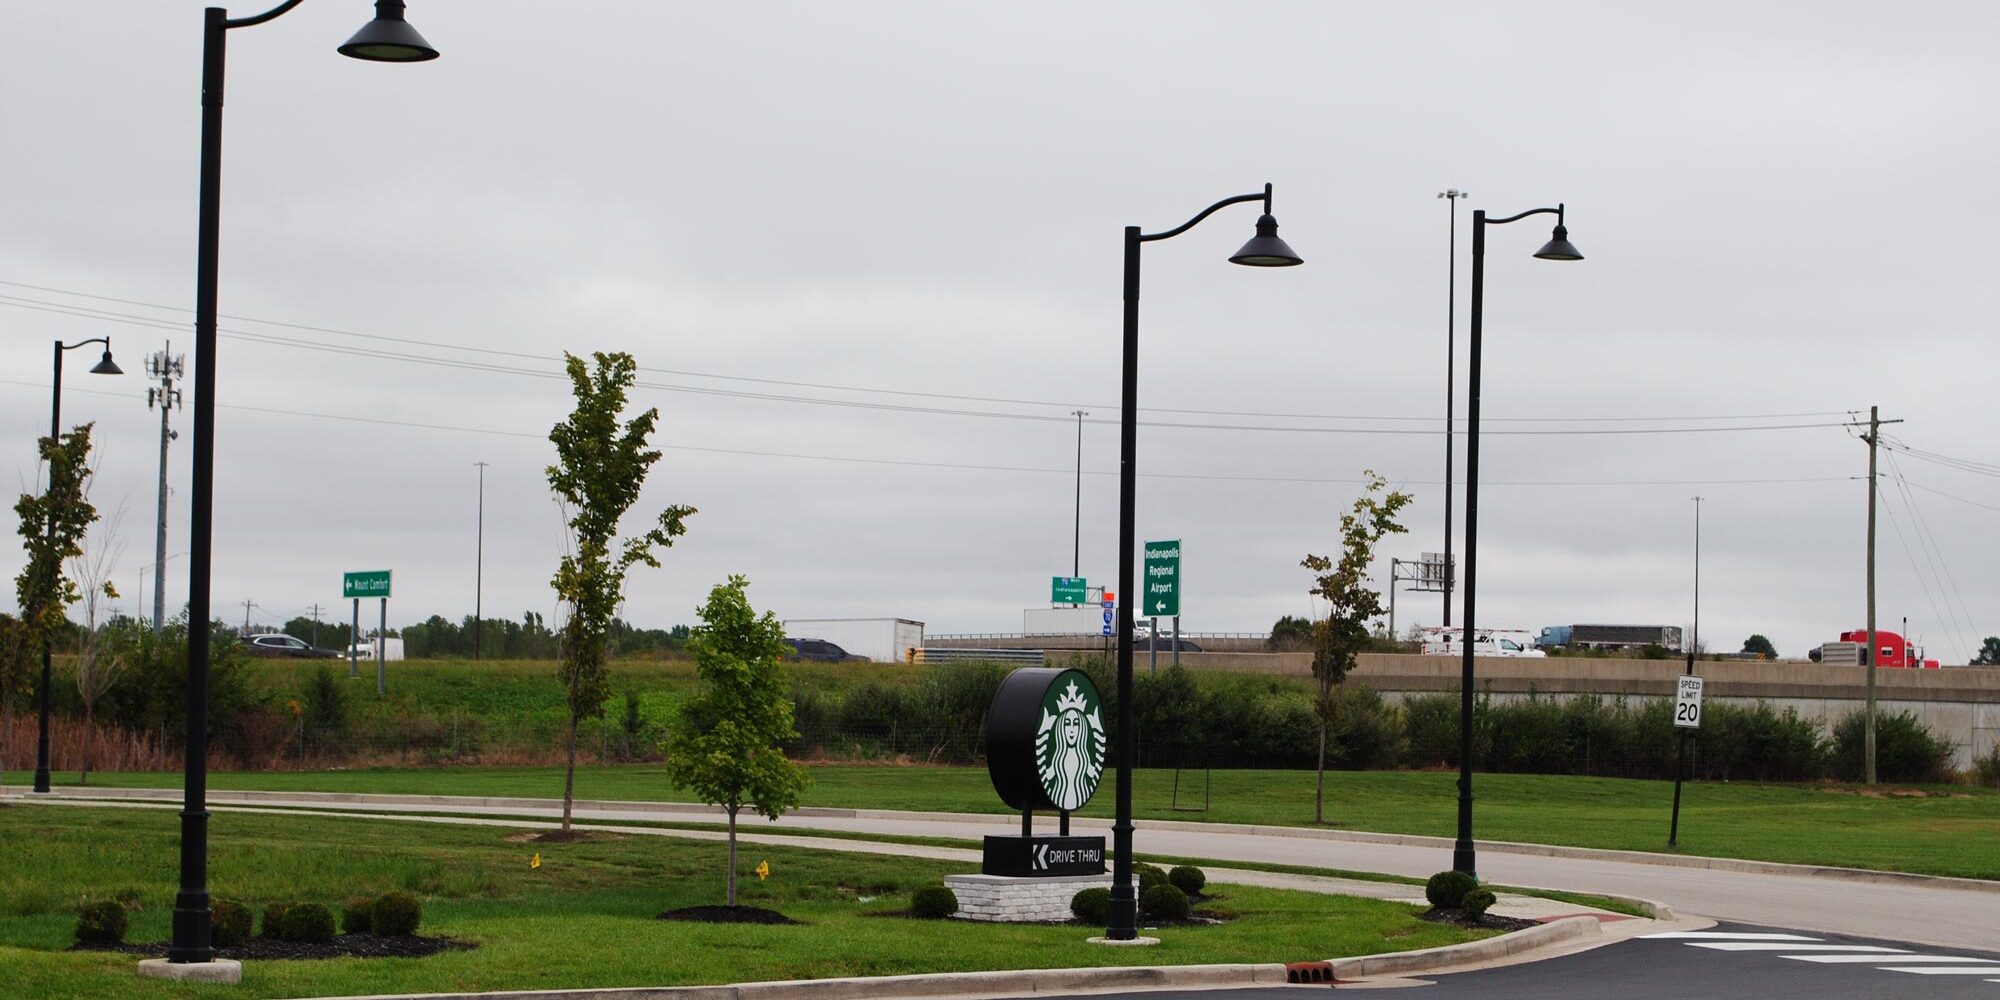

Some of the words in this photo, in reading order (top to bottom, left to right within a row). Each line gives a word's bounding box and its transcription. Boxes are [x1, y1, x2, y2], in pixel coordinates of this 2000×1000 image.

[1145, 548, 1179, 560] Indianapolis
[1149, 565, 1174, 579] Regional
[355, 579, 368, 590] Mount
[370, 579, 388, 590] Comfort
[1150, 582, 1172, 594] Airport
[1680, 680, 1700, 690] SPEED
[1681, 691, 1697, 699] LIMIT
[1677, 702, 1698, 722] 20
[1049, 849, 1075, 863] DRIVE
[1077, 849, 1100, 863] THRU
